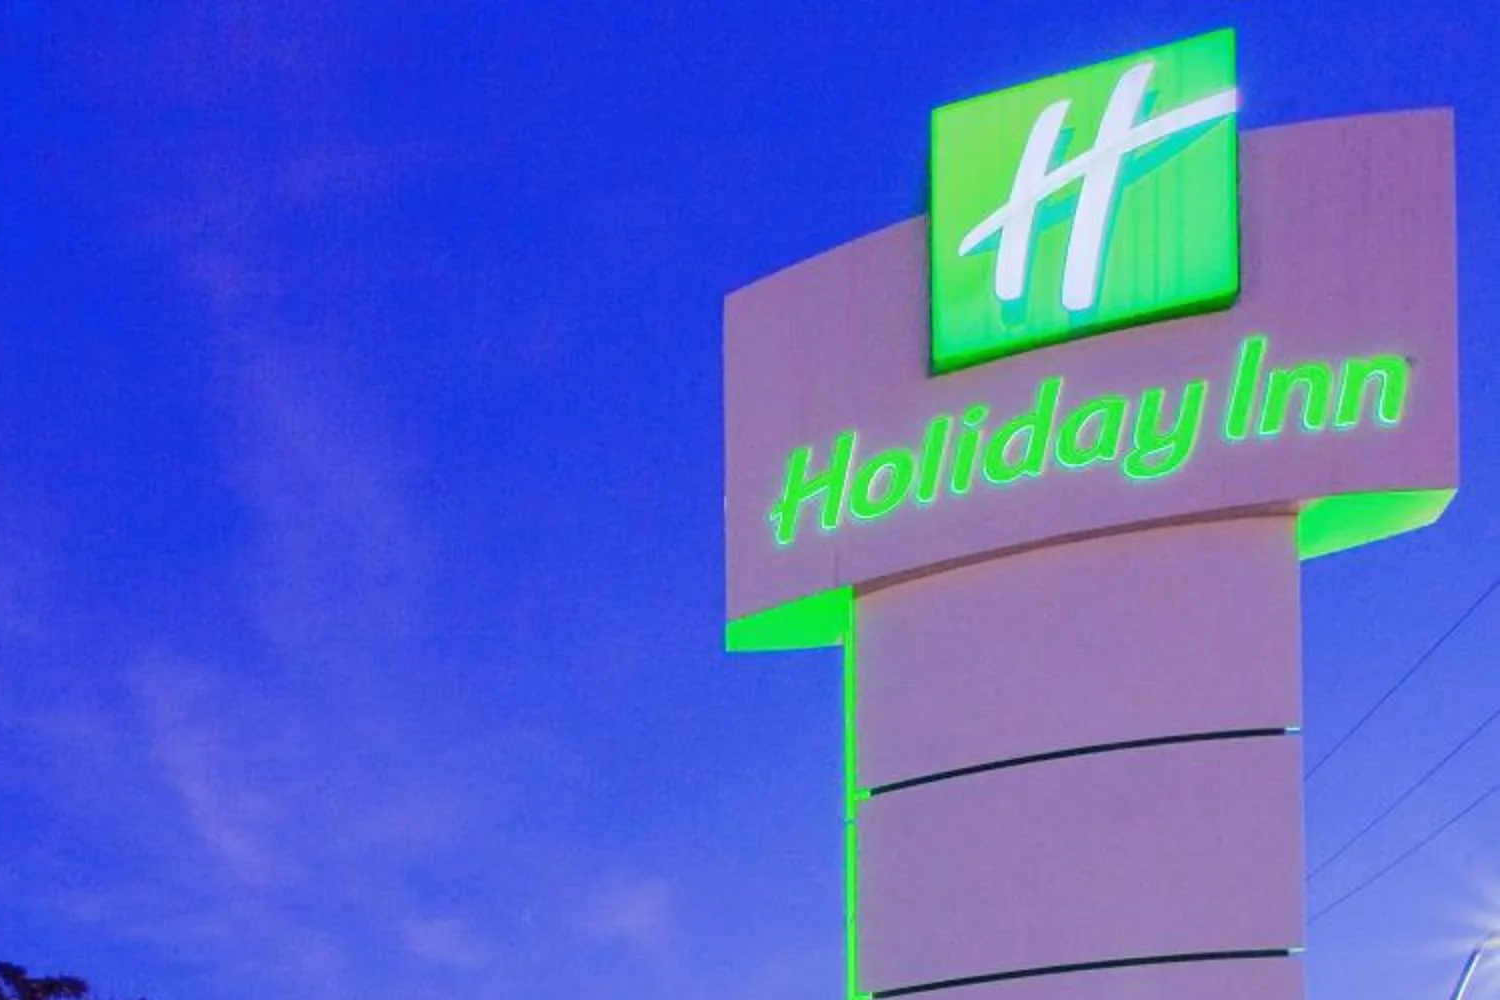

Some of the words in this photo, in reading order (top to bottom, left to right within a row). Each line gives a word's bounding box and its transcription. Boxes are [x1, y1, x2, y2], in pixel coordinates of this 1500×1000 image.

[958, 60, 1238, 310] H
[769, 377, 1205, 545] Holiday
[1224, 336, 1407, 442] Inn
